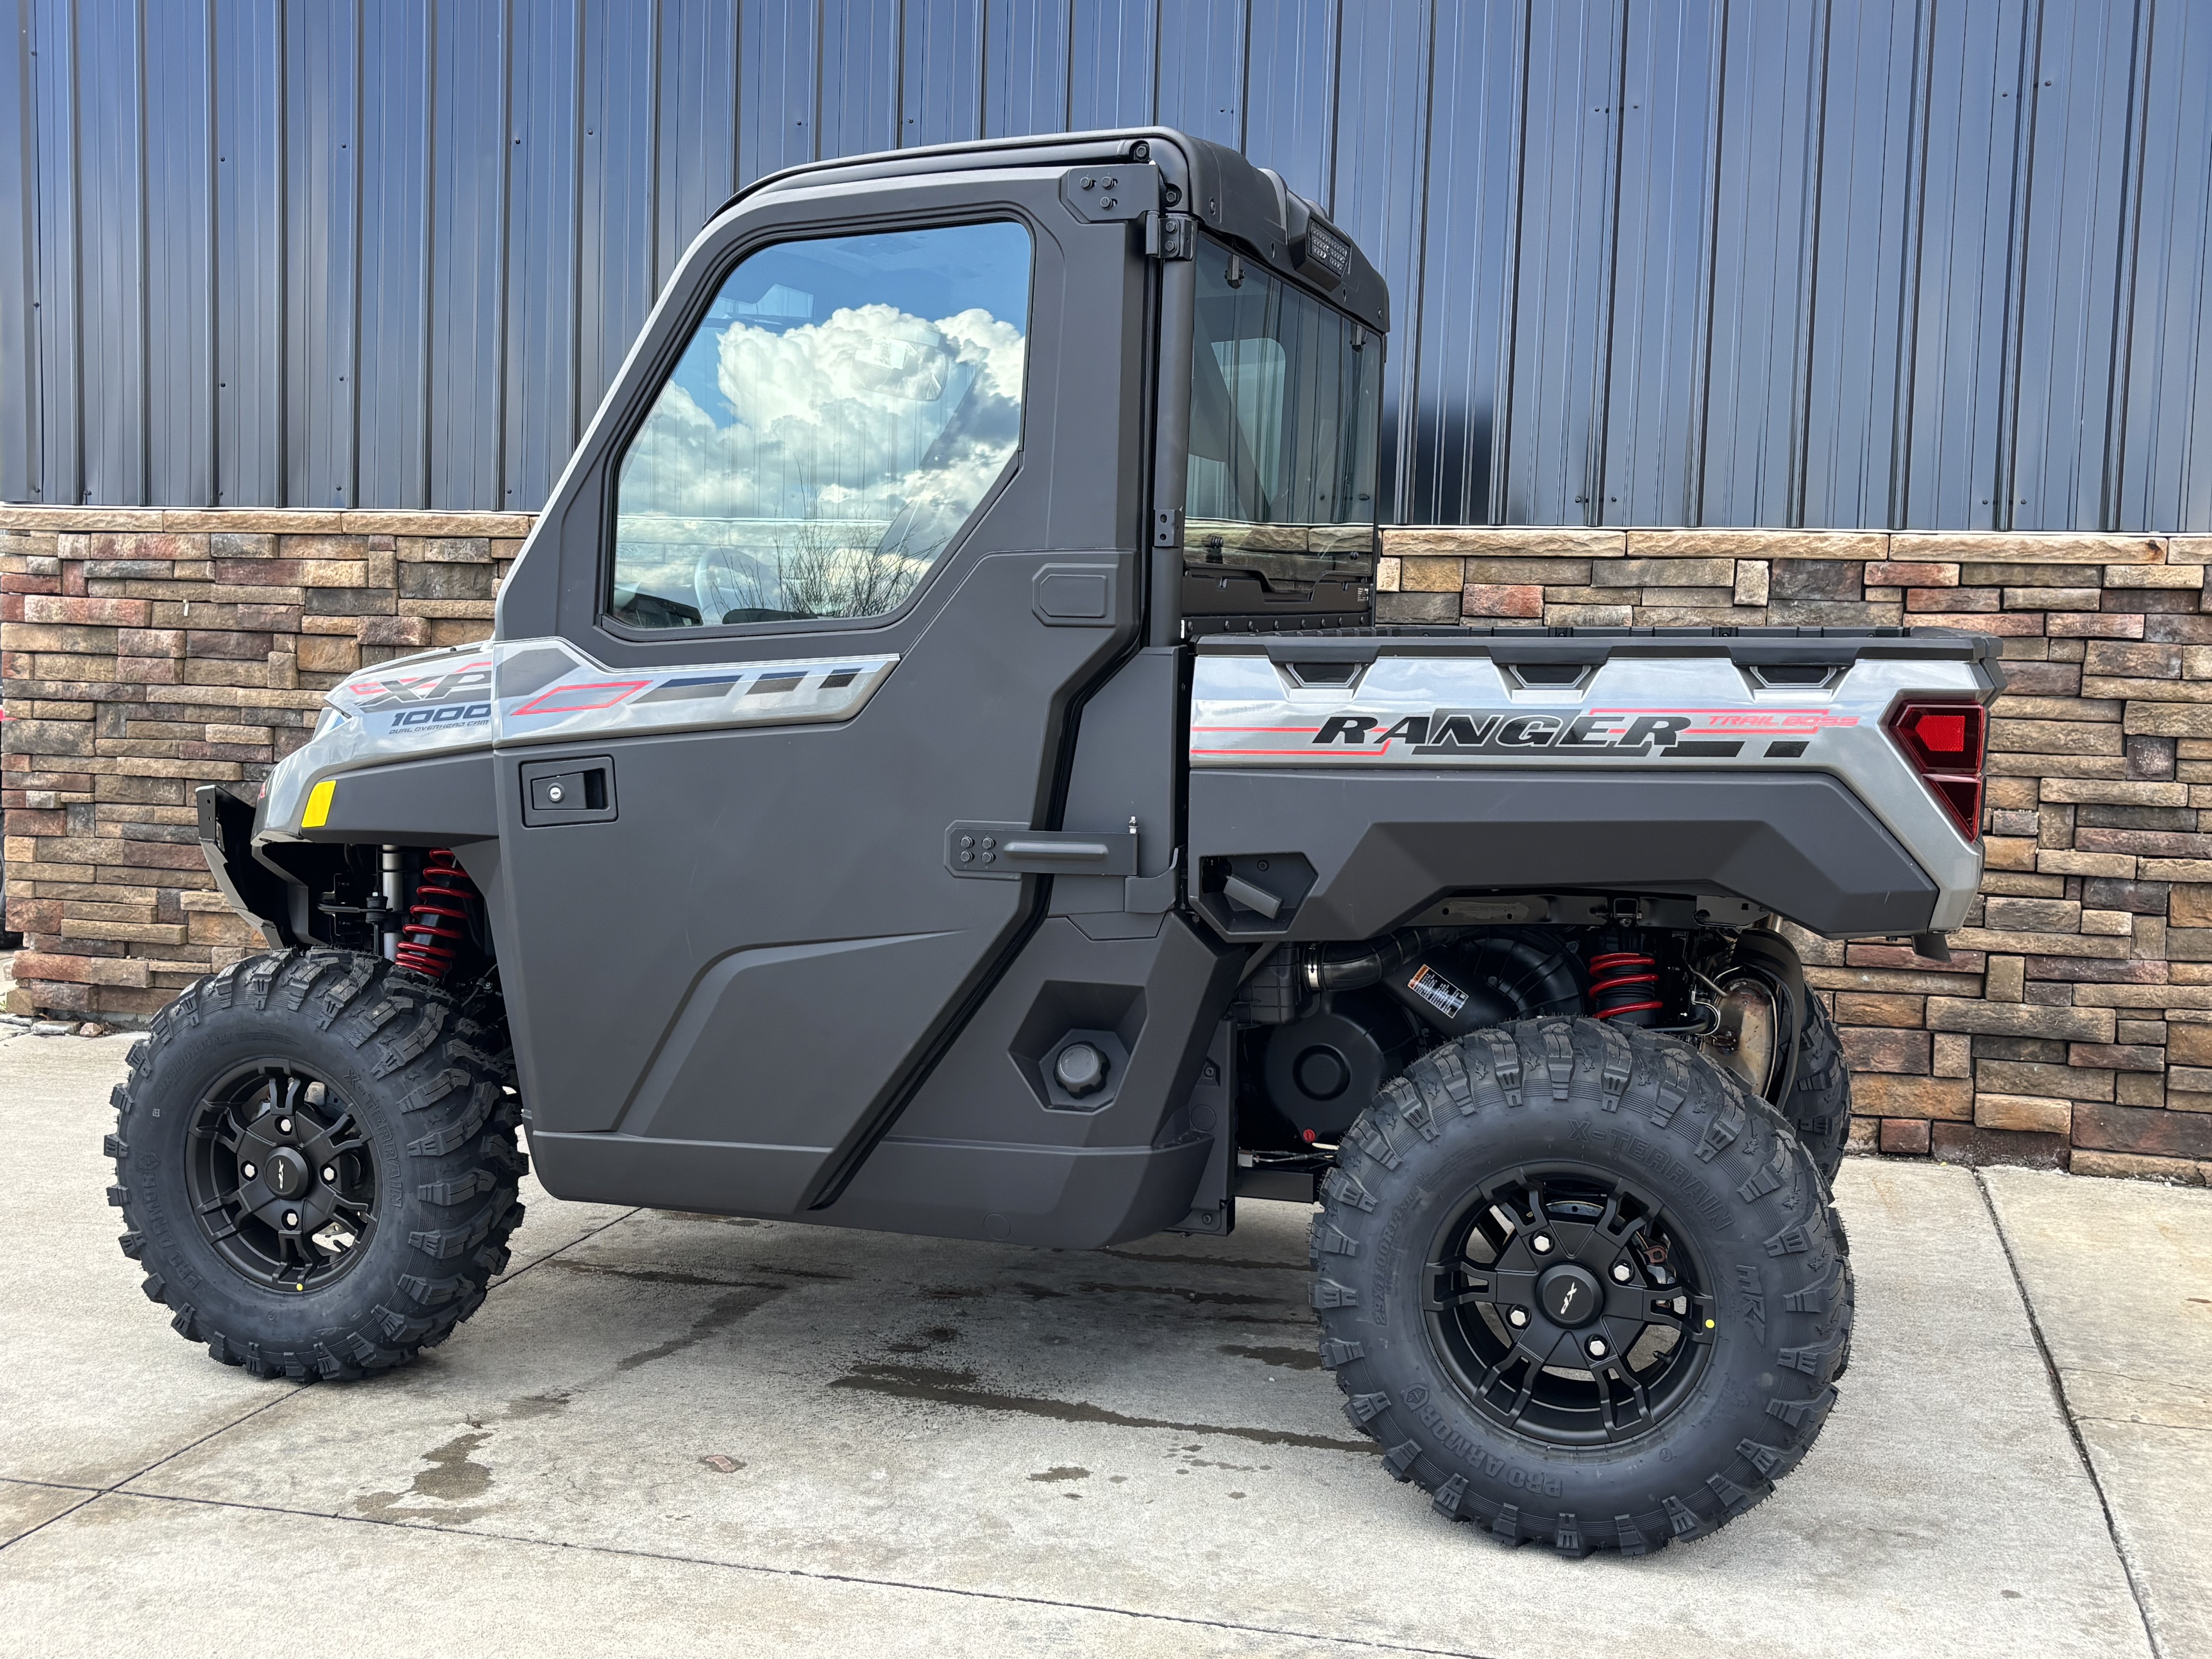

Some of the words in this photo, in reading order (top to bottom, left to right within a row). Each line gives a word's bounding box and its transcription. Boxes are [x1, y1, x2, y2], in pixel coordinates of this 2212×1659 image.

[356, 670, 492, 707] XP
[392, 703, 491, 727] 1000
[414, 722, 465, 732] OVERHEAD
[1310, 714, 1692, 747] RANGER
[1709, 716, 1779, 726] TRAIL
[1781, 716, 1860, 726] BOSS
[343, 1066, 403, 1208] X-TERRAIN
[1567, 1119, 1736, 1231] X-TERRAIN
[1560, 1281, 1578, 1315] XP
[1418, 1404, 1505, 1478] ARMOR
[1506, 1467, 1563, 1498] PRO
